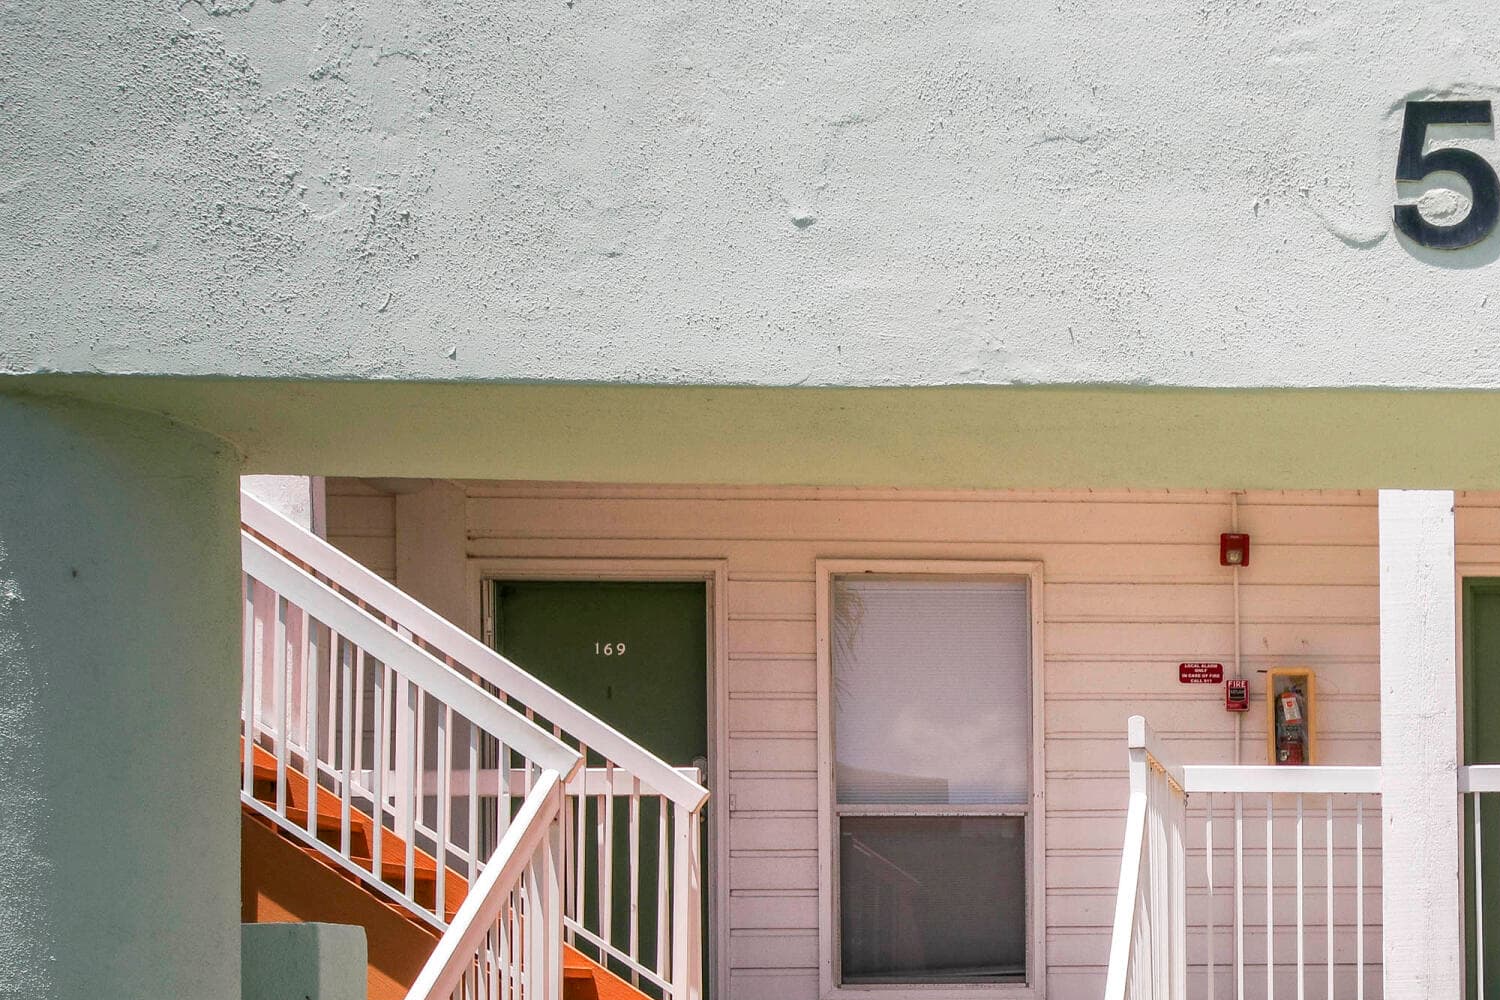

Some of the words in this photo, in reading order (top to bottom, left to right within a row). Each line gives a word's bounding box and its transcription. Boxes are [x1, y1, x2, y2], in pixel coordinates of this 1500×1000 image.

[1393, 100, 1500, 250] 5
[595, 642, 626, 656] 169
[1228, 680, 1246, 688] FIRE
